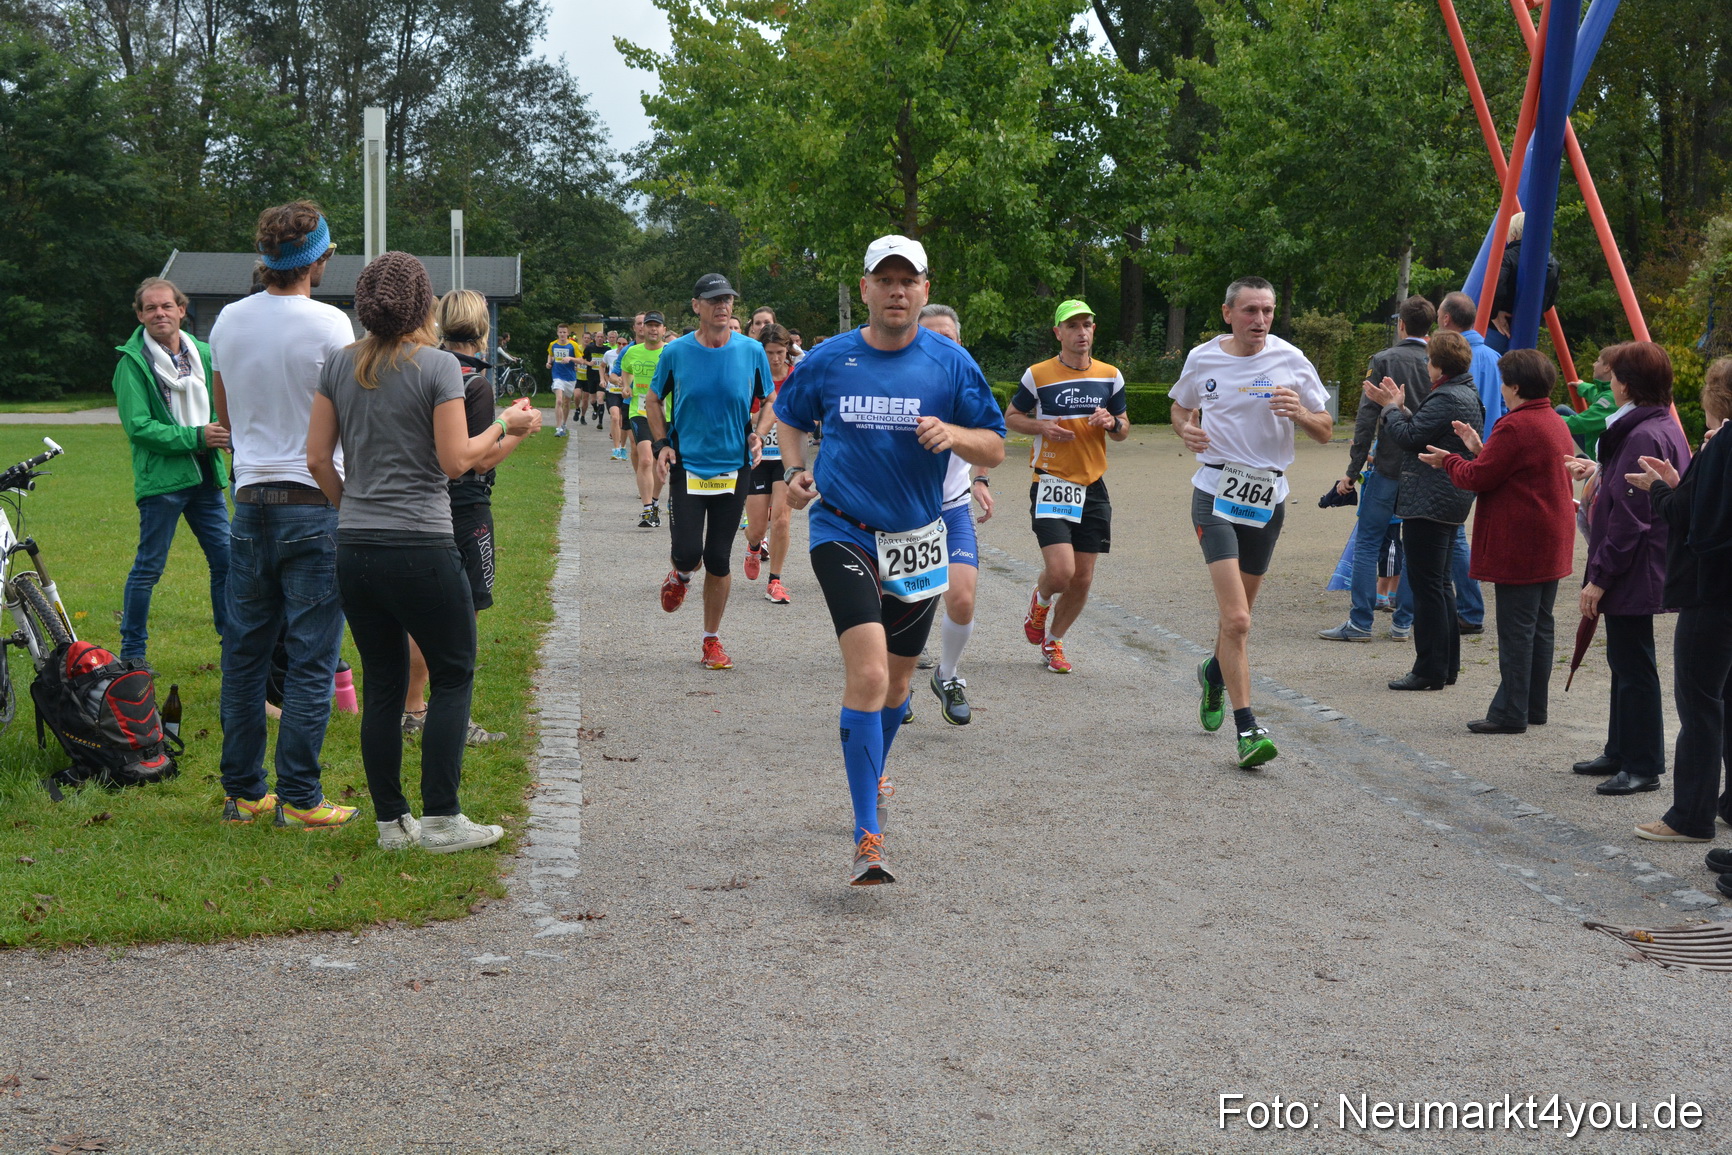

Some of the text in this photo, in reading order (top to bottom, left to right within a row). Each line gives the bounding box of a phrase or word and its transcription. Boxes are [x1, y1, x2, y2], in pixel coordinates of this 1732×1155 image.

[839, 395, 921, 415] HUBER
[1065, 394, 1103, 405] Fischer
[855, 413, 917, 423] TECHNOLOGY
[1224, 466, 1245, 478] PARTL
[699, 481, 728, 489] Volkmar
[1222, 476, 1275, 507] 2464
[250, 490, 289, 503] PMA
[1042, 485, 1083, 505] 2686
[1052, 506, 1073, 515] Bernd
[1230, 505, 1256, 519] Martin
[885, 537, 942, 577] 2935
[904, 576, 931, 593] Ralph
